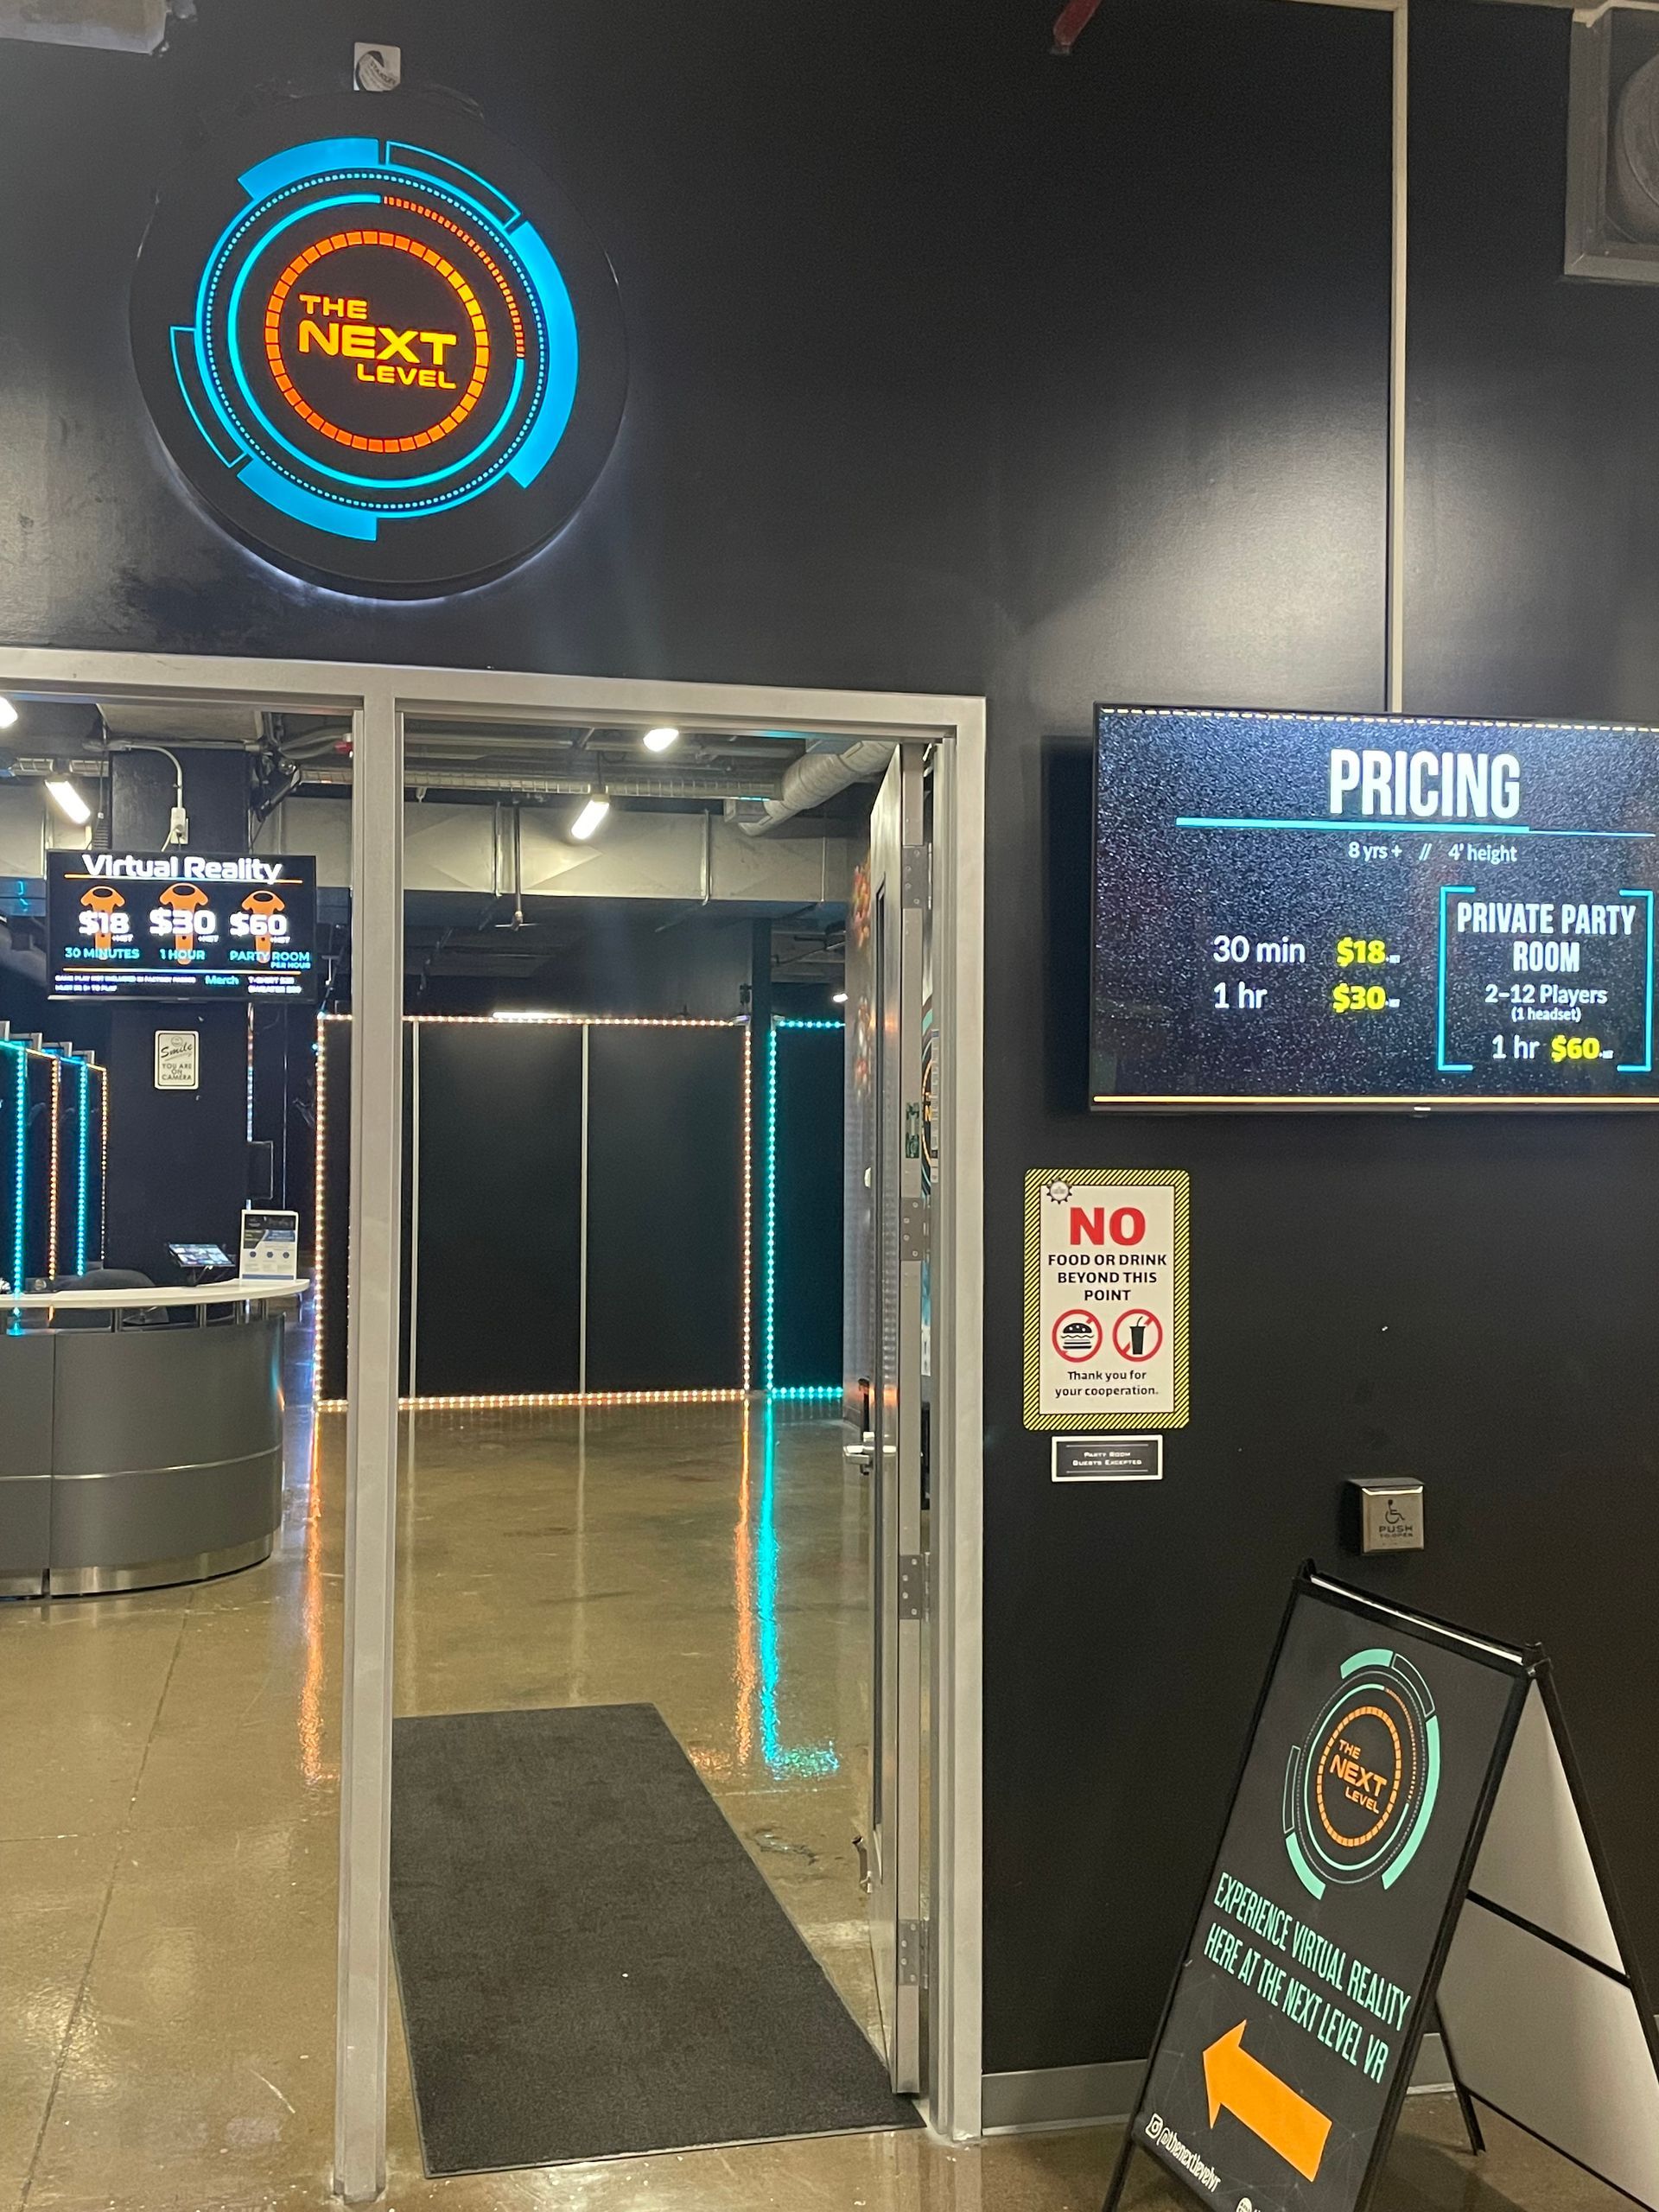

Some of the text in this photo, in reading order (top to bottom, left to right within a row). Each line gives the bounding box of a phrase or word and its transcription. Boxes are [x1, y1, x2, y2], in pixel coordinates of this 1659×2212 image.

[299, 294, 367, 320] THE
[298, 320, 457, 365] NEXT
[357, 363, 456, 389] LEVEL
[1330, 748, 1521, 819] PRICING
[1348, 842, 1360, 858] 8
[1363, 844, 1389, 861] yrs
[1467, 843, 1518, 865] height
[82, 854, 283, 885] Virtual Reality
[79, 910, 130, 935] $18
[149, 907, 216, 936] $30
[230, 912, 288, 937] $60
[1457, 902, 1636, 935] PRIVATE PARTY
[65, 947, 140, 960] 30 MINUTES
[159, 949, 206, 960] 1 HOUR
[229, 950, 310, 962] PARTY ROOM
[1213, 935, 1386, 967] 30 min $18
[1513, 941, 1580, 972] ROOM
[205, 976, 239, 985] Merch
[1214, 981, 1386, 1013] 1 hr $30
[1484, 984, 1608, 1007] 2-12 Players
[1511, 1007, 1581, 1022] (1 headset)
[161, 1042, 193, 1058] Smile
[1492, 1035, 1507, 1058] 1
[1514, 1035, 1540, 1058] hr
[1551, 1034, 1600, 1062] $60
[1070, 1207, 1146, 1246] NO
[1048, 1255, 1166, 1266] FOOD OR DRINK
[1058, 1272, 1158, 1283] BEYOND THIS
[1084, 1290, 1131, 1301] POINT
[1068, 1370, 1147, 1382] Thank you for
[1055, 1386, 1159, 1398] your cooperation.
[1339, 1739, 1361, 1759] THE
[1330, 1754, 1388, 1796] NEXT
[1344, 1786, 1380, 1814] LEVEL
[1213, 1872, 1411, 2031] EXPERIENCE VIRTUAL REALITY
[1204, 1923, 1389, 2083] HERE AT THE NEXT LEVEL VR
